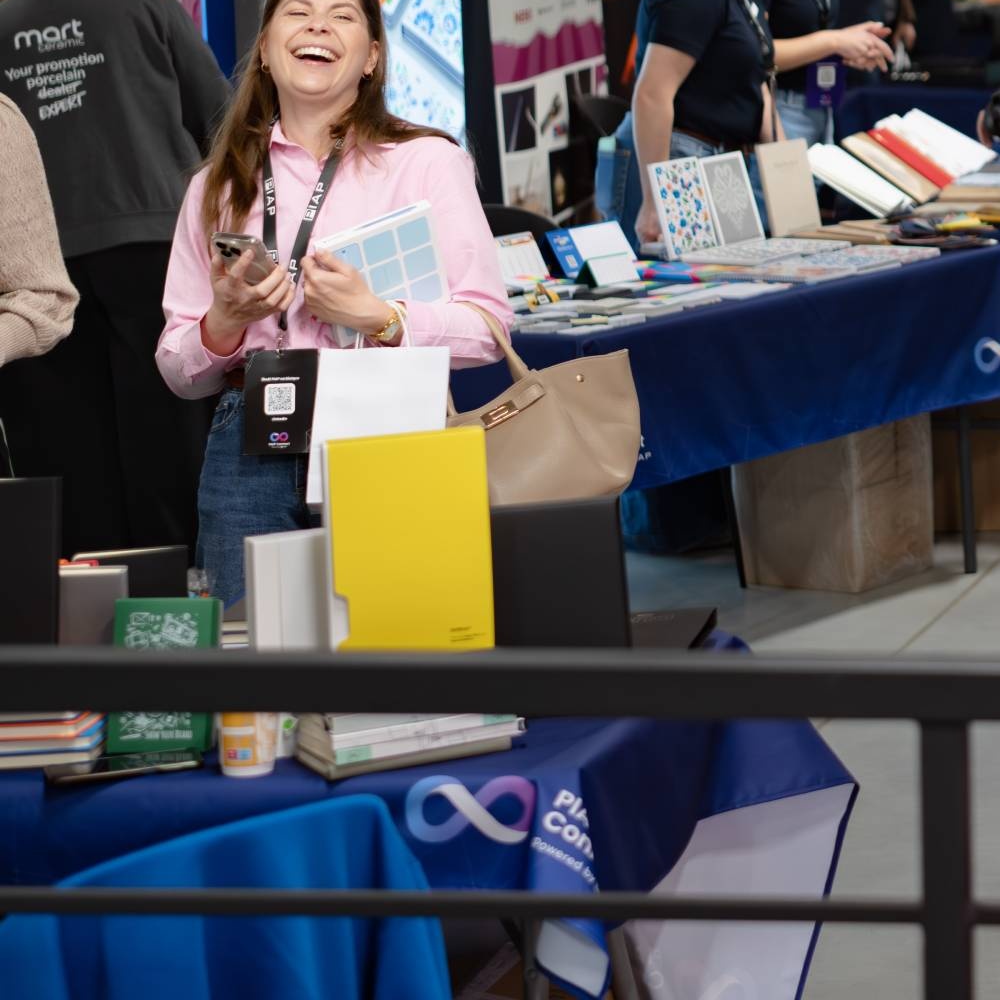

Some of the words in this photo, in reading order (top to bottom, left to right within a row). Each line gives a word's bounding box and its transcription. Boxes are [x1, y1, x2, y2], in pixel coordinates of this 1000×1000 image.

[14, 19, 84, 50] mart
[38, 38, 85, 52] ceramic
[4, 65, 34, 82] Your
[36, 53, 105, 75] promotion
[27, 67, 86, 90] porcelain
